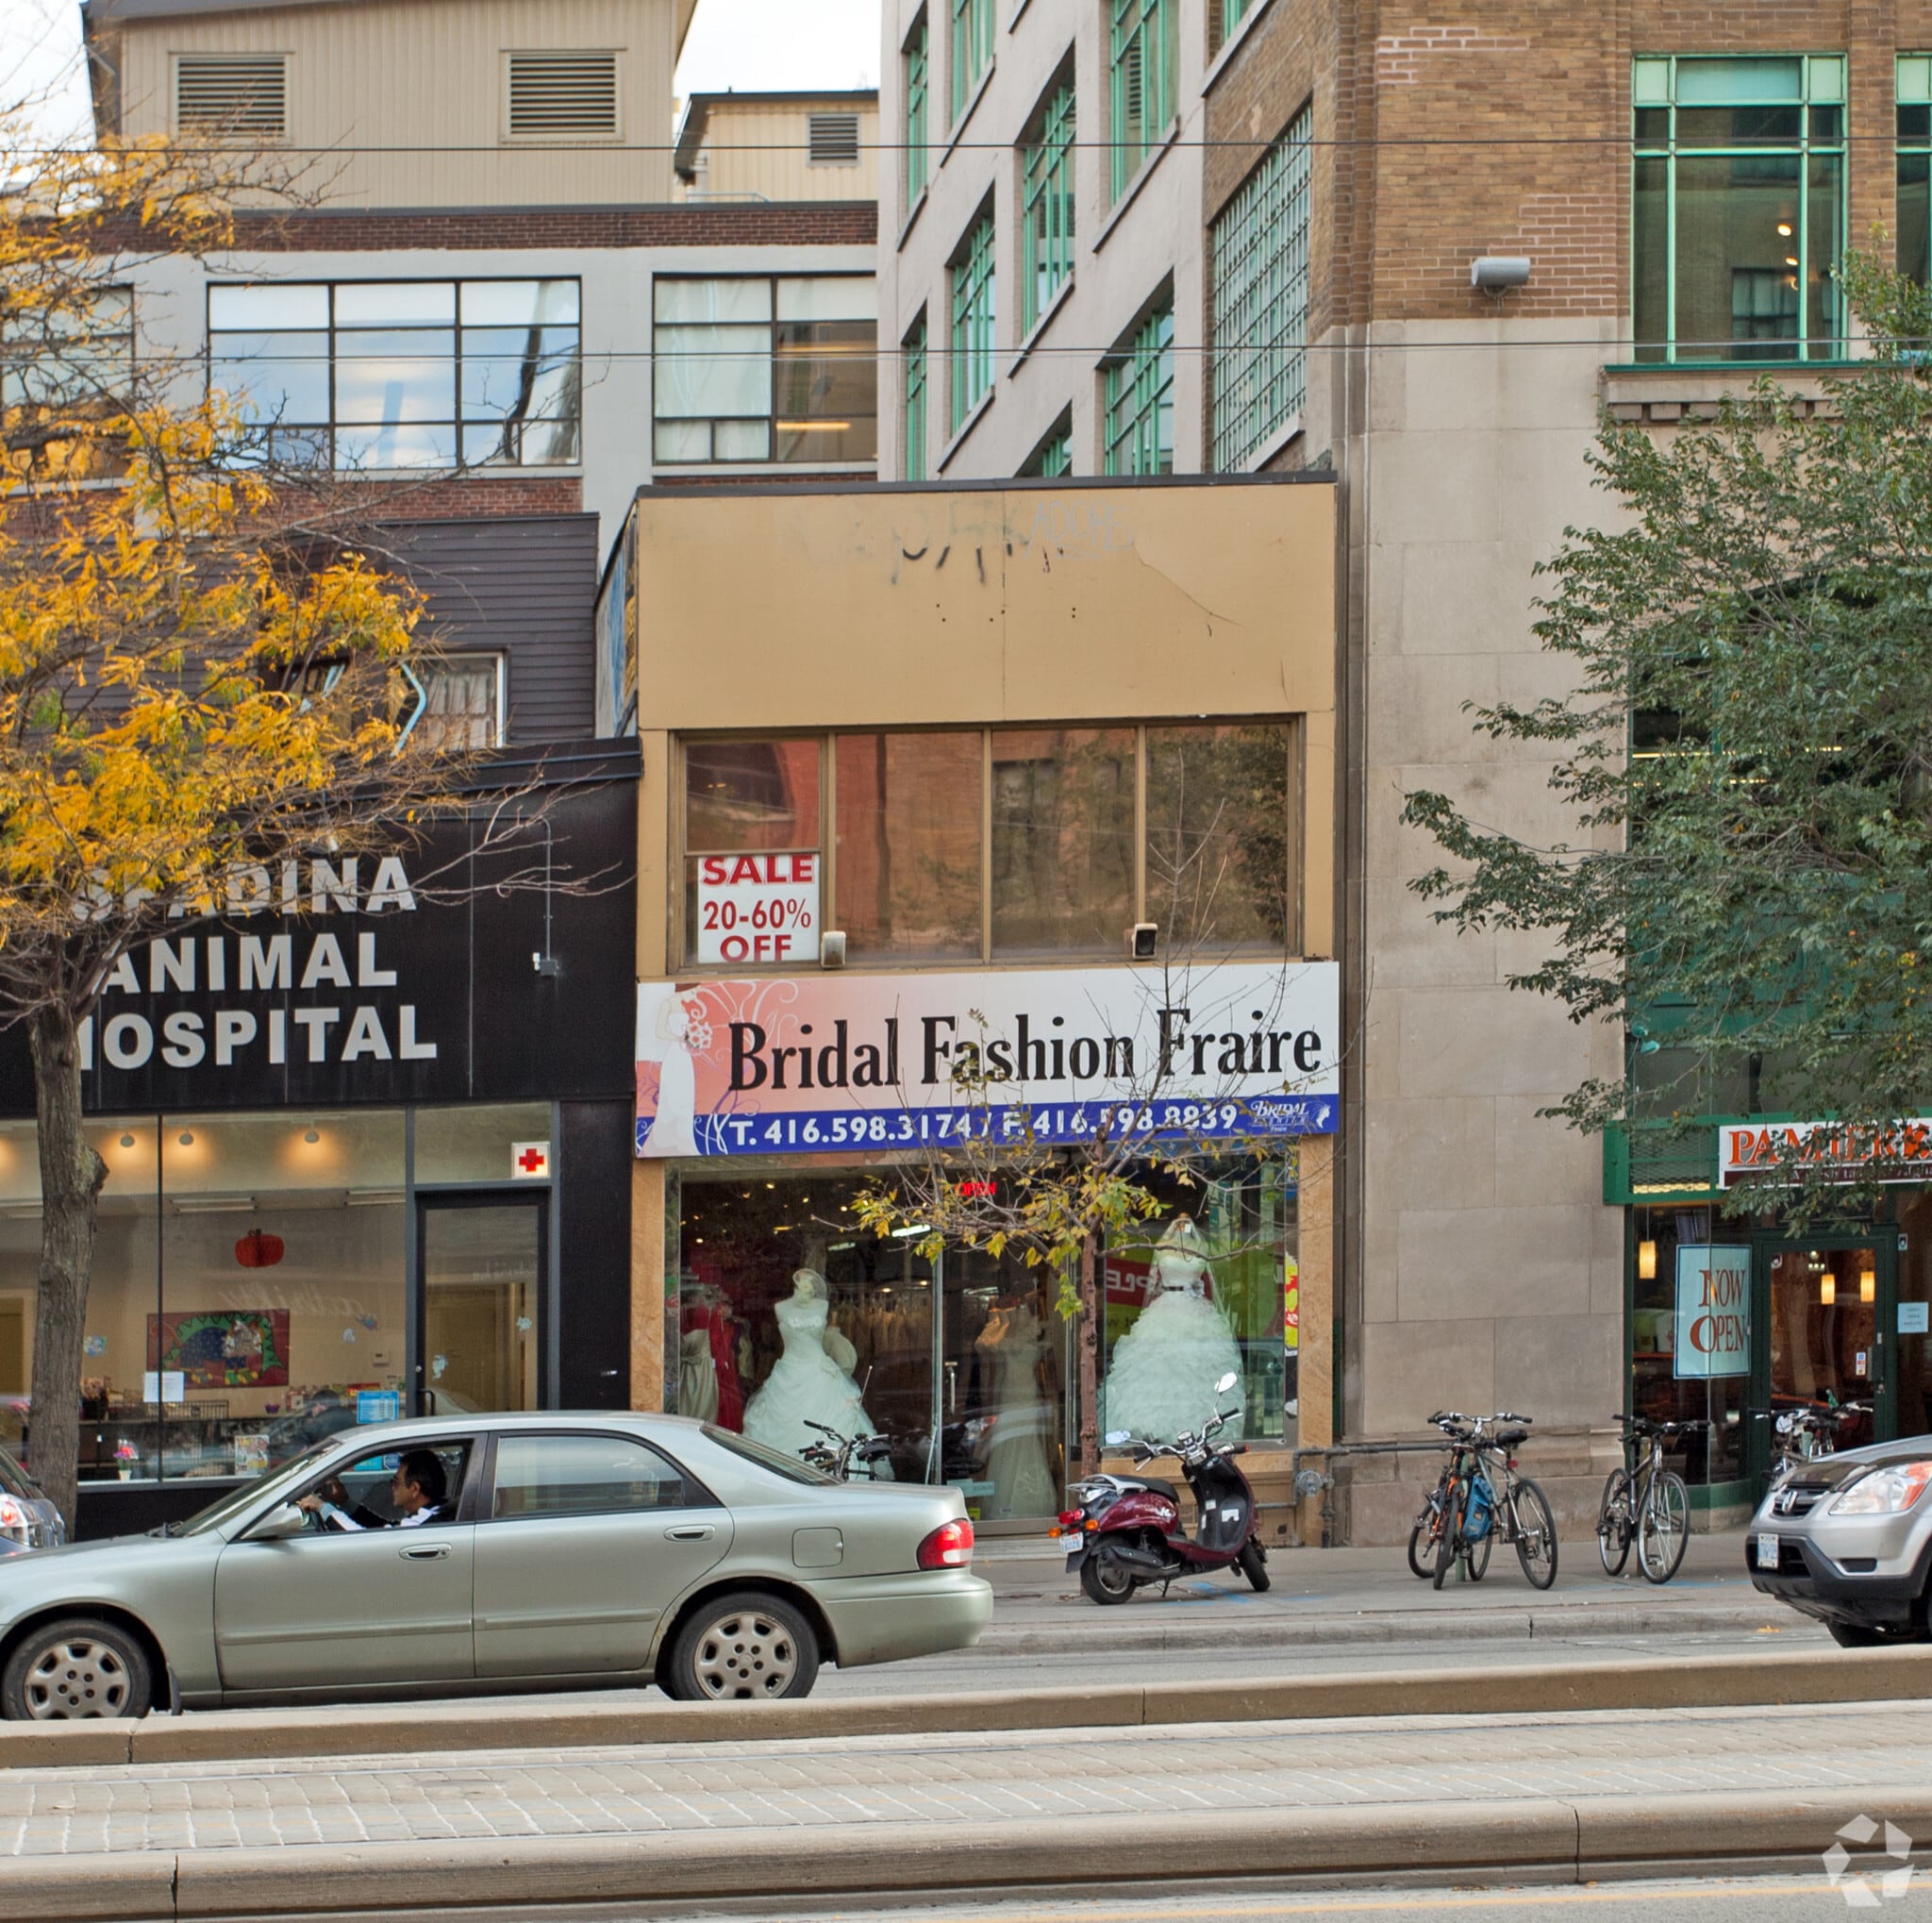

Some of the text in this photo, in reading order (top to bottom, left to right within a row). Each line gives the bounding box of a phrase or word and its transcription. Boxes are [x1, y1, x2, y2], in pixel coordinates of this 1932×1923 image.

[702, 853, 816, 886] SALE
[703, 898, 811, 930] 20-60%
[97, 931, 397, 994] ANIMAL
[720, 933, 792, 962] OFF
[727, 1008, 1323, 1092] Bridal Fashion Fraire
[728, 1121, 758, 1146] T.
[764, 1113, 973, 1145] 416.598.3174
[954, 1180, 997, 1196] OPEN
[1698, 1268, 1746, 1307] NOW
[1690, 1314, 1745, 1353] OPEN
